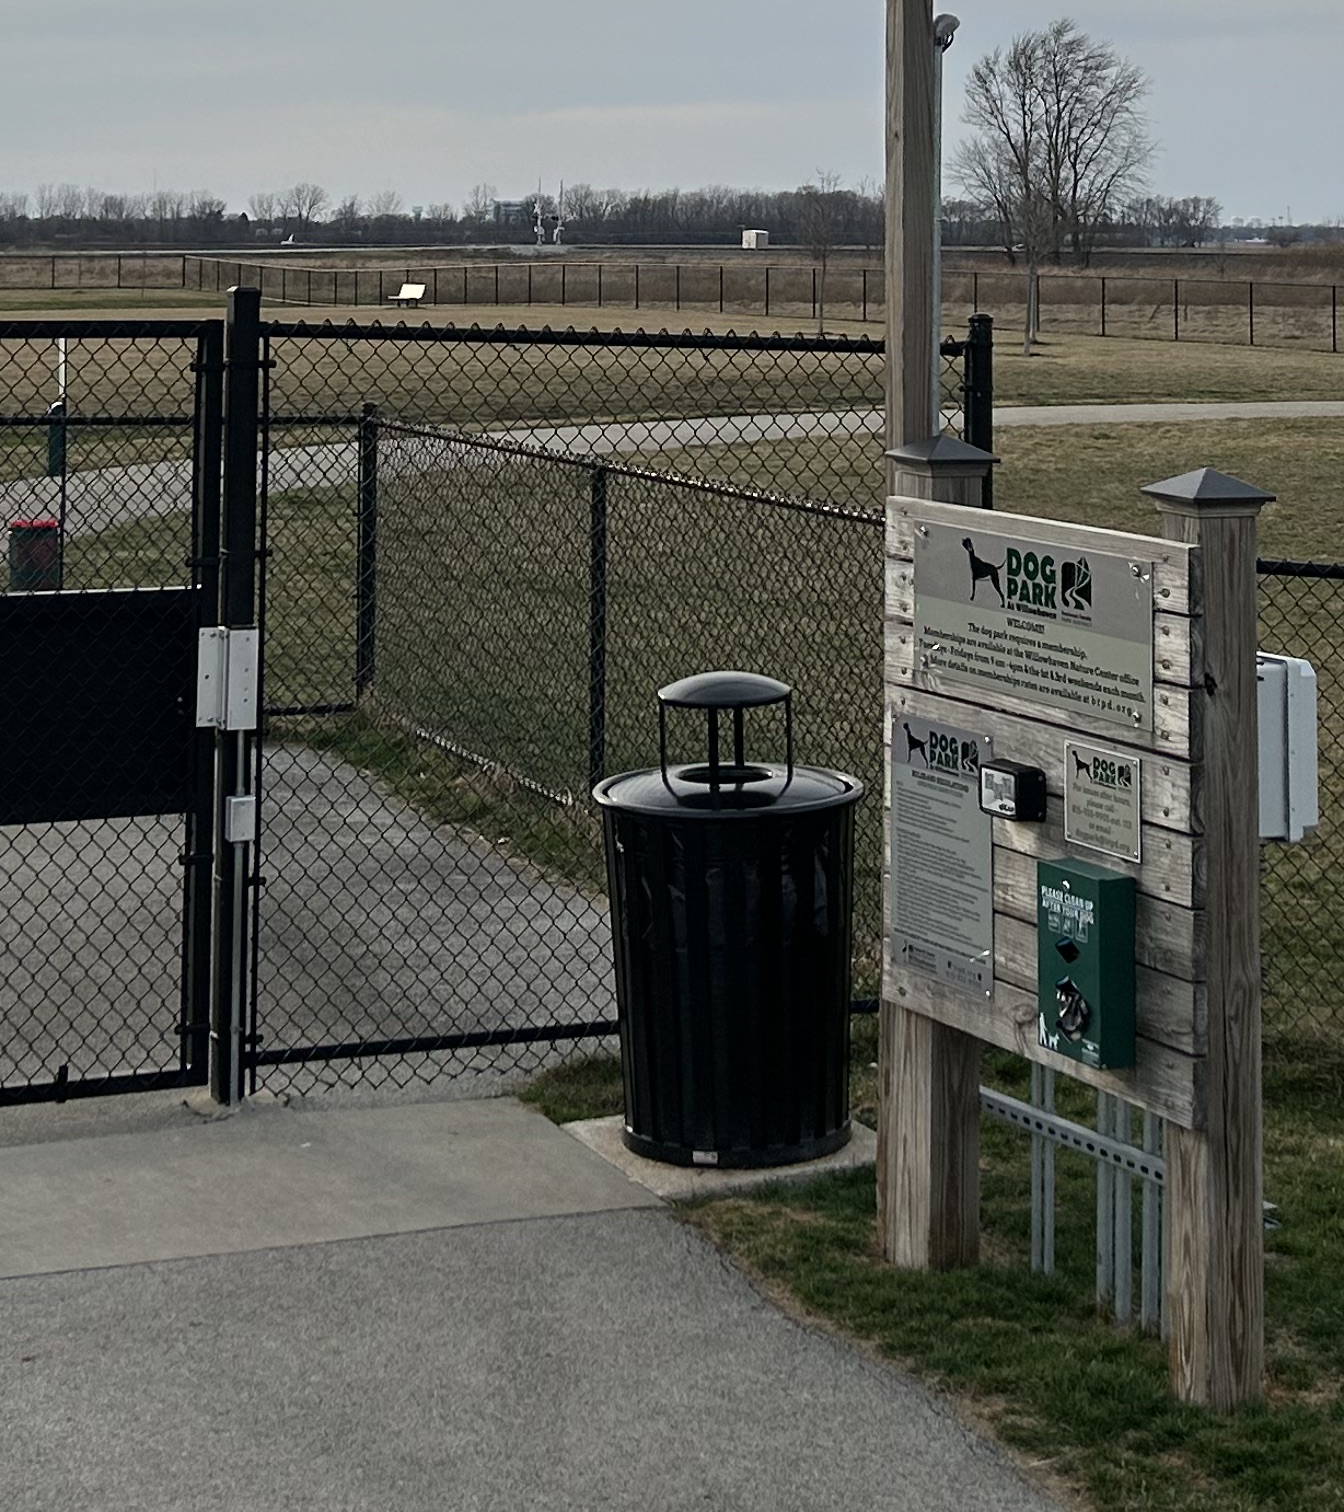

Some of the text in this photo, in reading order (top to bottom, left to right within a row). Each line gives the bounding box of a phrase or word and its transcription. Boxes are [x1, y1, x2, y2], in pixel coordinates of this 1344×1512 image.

[1006, 547, 1056, 584] DOG
[1006, 577, 1057, 610] PARK
[968, 622, 980, 634] The
[980, 625, 992, 639] dog
[993, 628, 1008, 641] park
[1009, 634, 1036, 648] requires
[923, 625, 1140, 687] Memberships are available at the Willowhaven Nature Center office
[930, 654, 947, 667] More
[948, 659, 968, 673] details
[969, 667, 977, 675] on
[1021, 680, 1038, 691] rates
[1039, 684, 1049, 694] are
[1050, 685, 1082, 702] available
[1083, 696, 1089, 705] at
[950, 646, 974, 662] Fridays
[974, 651, 990, 664] from
[1029, 666, 1040, 677] the
[1067, 677, 1102, 692] weekends
[1103, 683, 1120, 697] each
[929, 730, 959, 755] DOG
[929, 749, 959, 771] PARK
[1092, 756, 1116, 775] DOG
[1092, 770, 1116, 785] PARK
[1041, 885, 1094, 911] PLEASE CLEAN UP
[1042, 897, 1061, 913] AFTER
